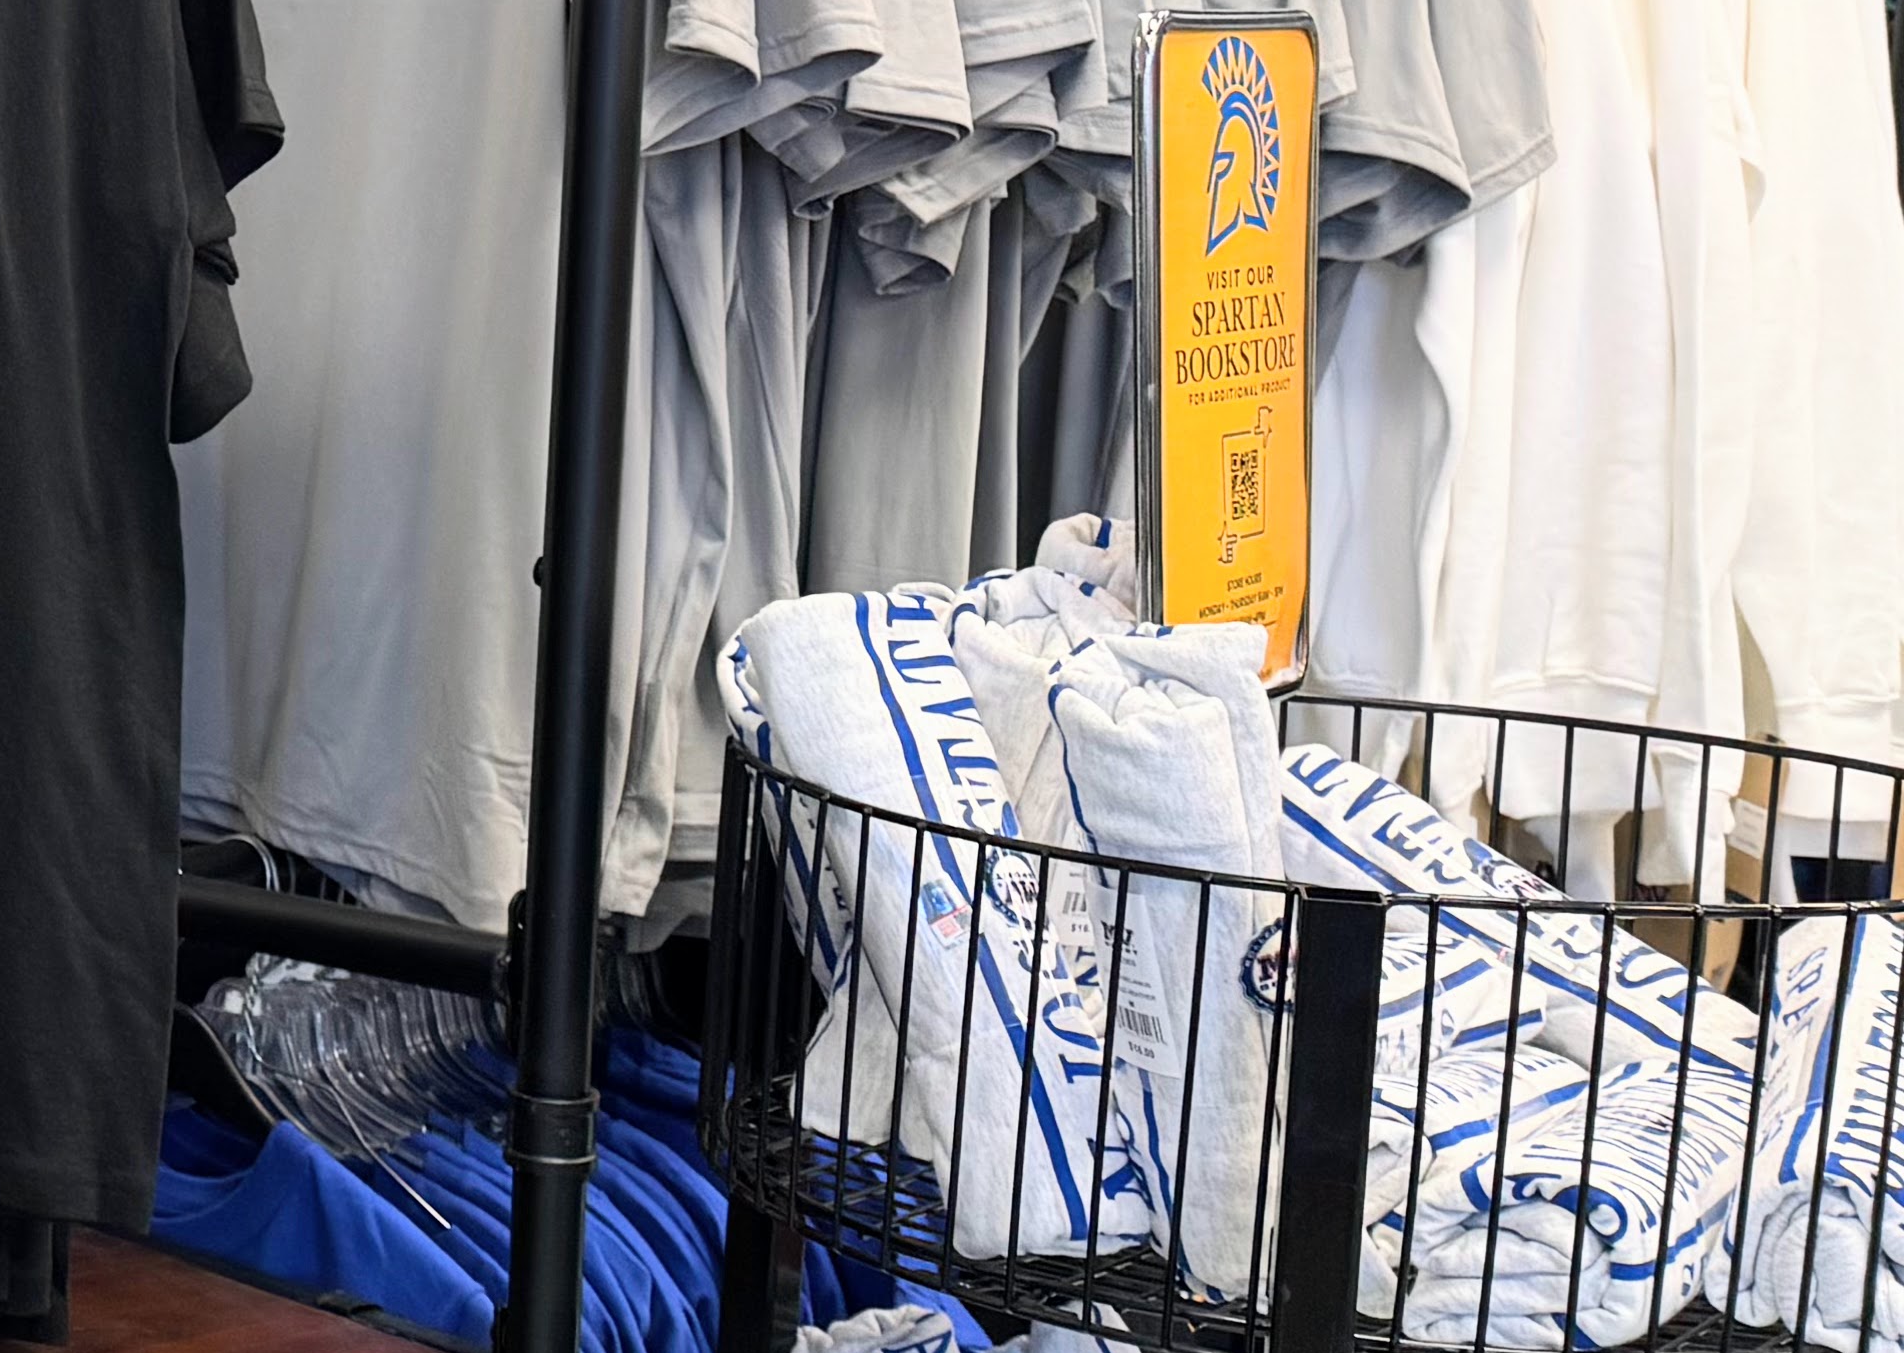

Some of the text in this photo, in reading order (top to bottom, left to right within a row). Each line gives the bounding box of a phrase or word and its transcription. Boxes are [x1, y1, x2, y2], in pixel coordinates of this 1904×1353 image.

[1207, 265, 1274, 291] VISIT OUR
[1192, 291, 1286, 338] SPARTAN
[1175, 333, 1297, 385] BOOKSTORE
